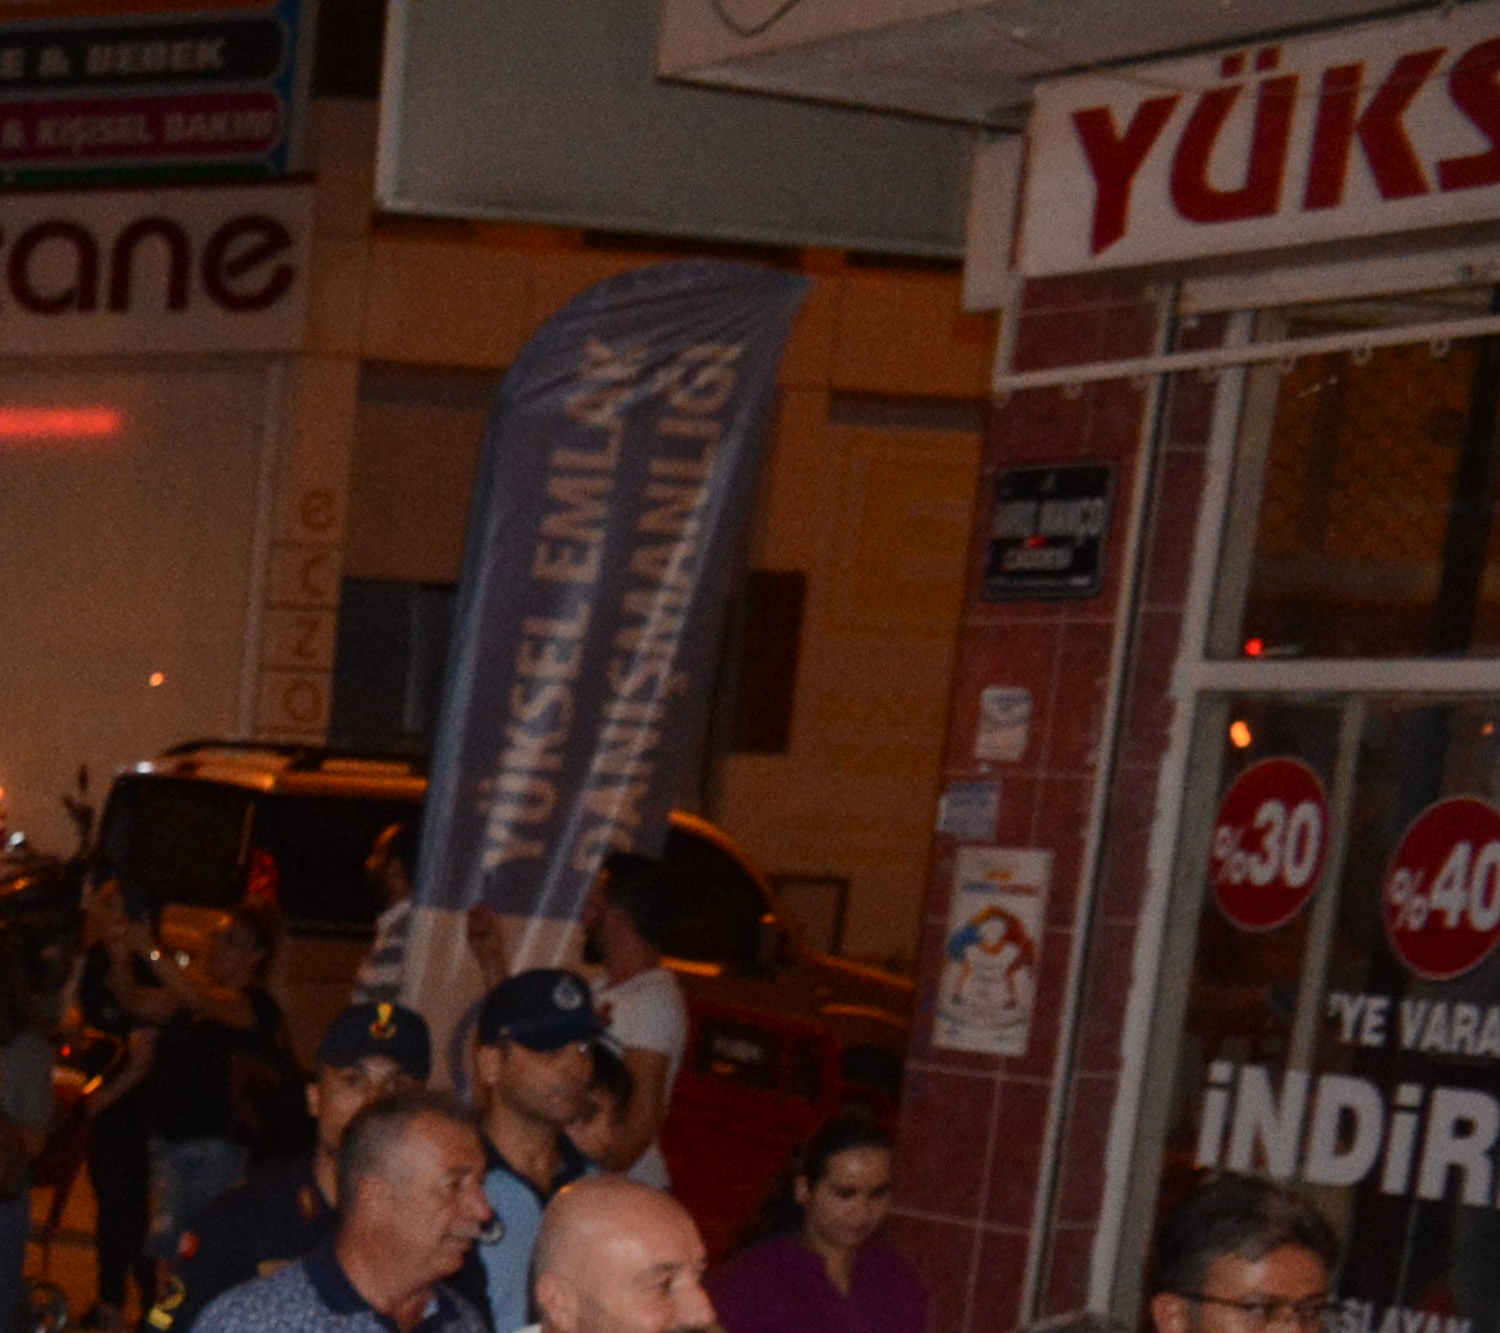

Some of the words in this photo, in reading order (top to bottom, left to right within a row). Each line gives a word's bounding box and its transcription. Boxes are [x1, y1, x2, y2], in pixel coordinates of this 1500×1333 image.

[85, 37, 227, 75] BEBEK
[532, 334, 650, 588] EMLAK
[479, 598, 593, 872] YÜKSEL
[1213, 797, 1322, 889] %30
